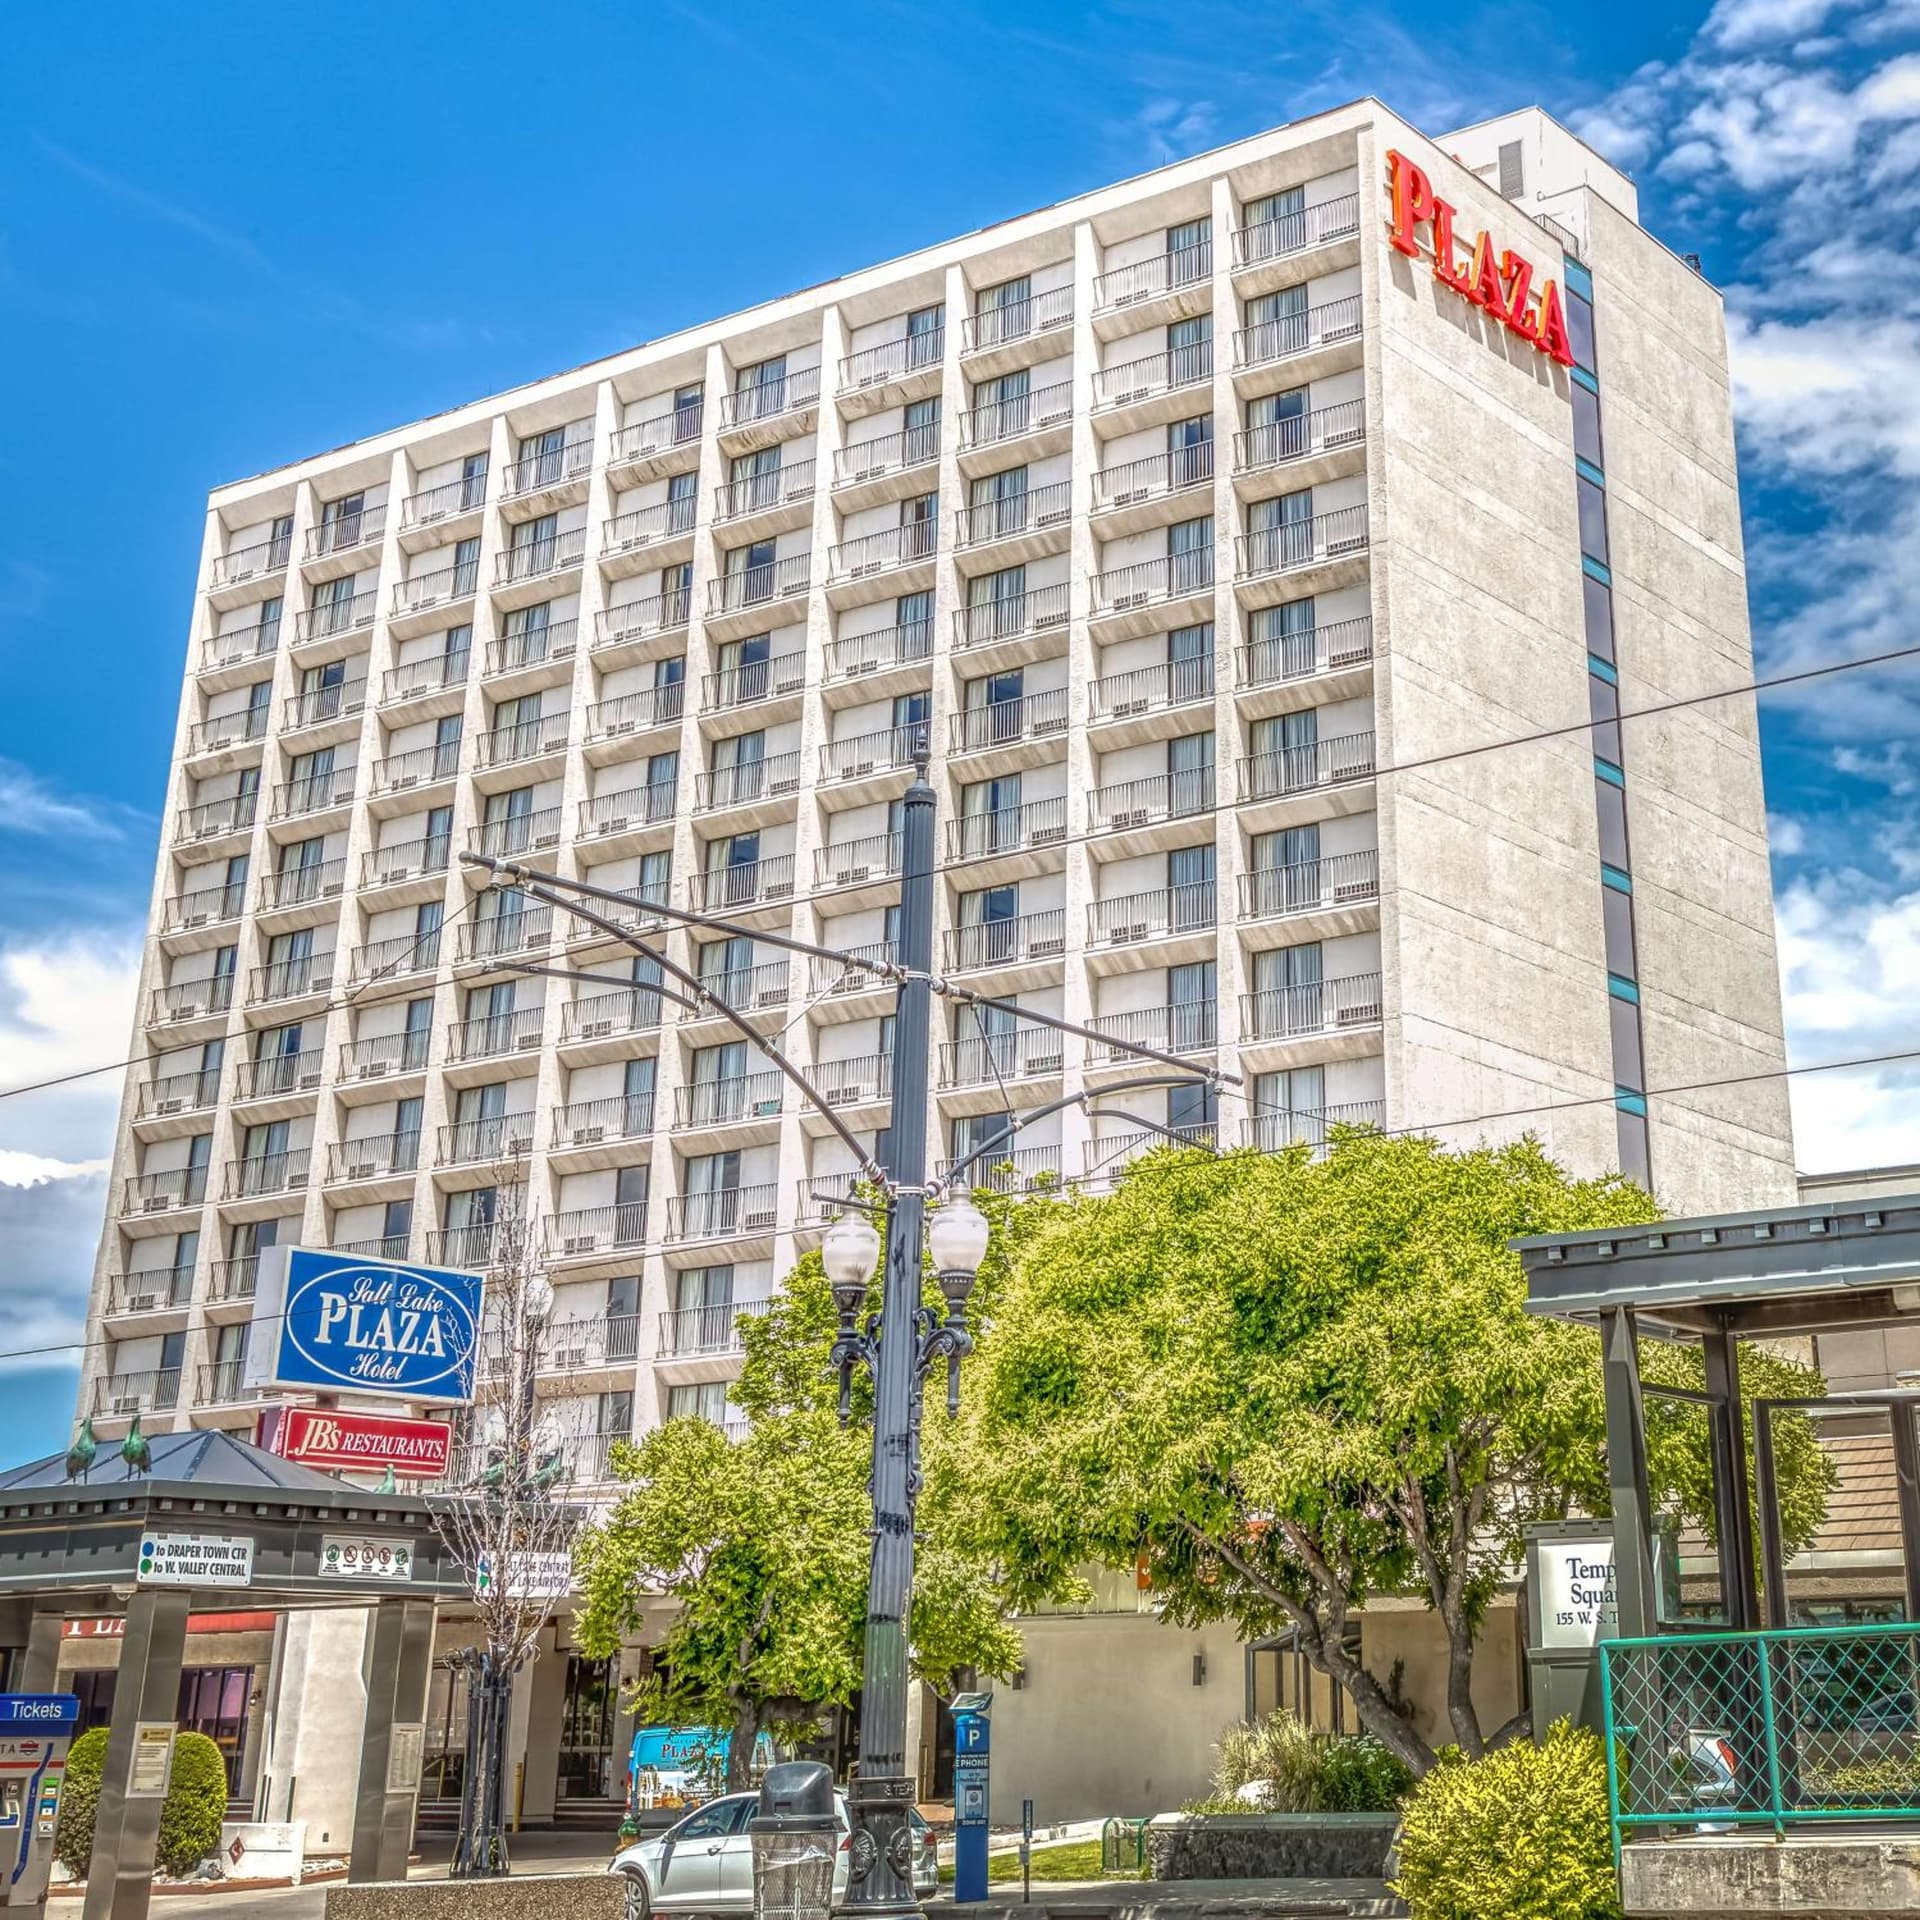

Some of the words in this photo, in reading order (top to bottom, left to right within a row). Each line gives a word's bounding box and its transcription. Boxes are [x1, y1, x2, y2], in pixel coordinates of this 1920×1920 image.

[1385, 149, 1576, 367] PLAZA
[348, 1276, 392, 1305] Salt
[395, 1283, 444, 1313] Lake
[313, 1292, 446, 1358] PLAZA
[350, 1352, 408, 1381] Hotel
[156, 1546, 166, 1557] to
[167, 1544, 201, 1558] DRAPER
[203, 1546, 229, 1560] TOWN
[231, 1547, 248, 1561] CTR
[153, 1562, 163, 1573] to
[165, 1560, 176, 1574] W.
[178, 1561, 209, 1575] VALLEY
[209, 1562, 247, 1577] CENTRAL
[1566, 1557, 1617, 1583] Temp
[1556, 1612, 1574, 1626] 155
[1577, 1611, 1592, 1625] W.
[1595, 1611, 1607, 1625] S.
[1609, 1610, 1619, 1624] T
[11, 1701, 62, 1718] Tickets
[969, 1729, 980, 1747] P
[0, 1744, 15, 1753] TA
[960, 1759, 989, 1768] PHONE
